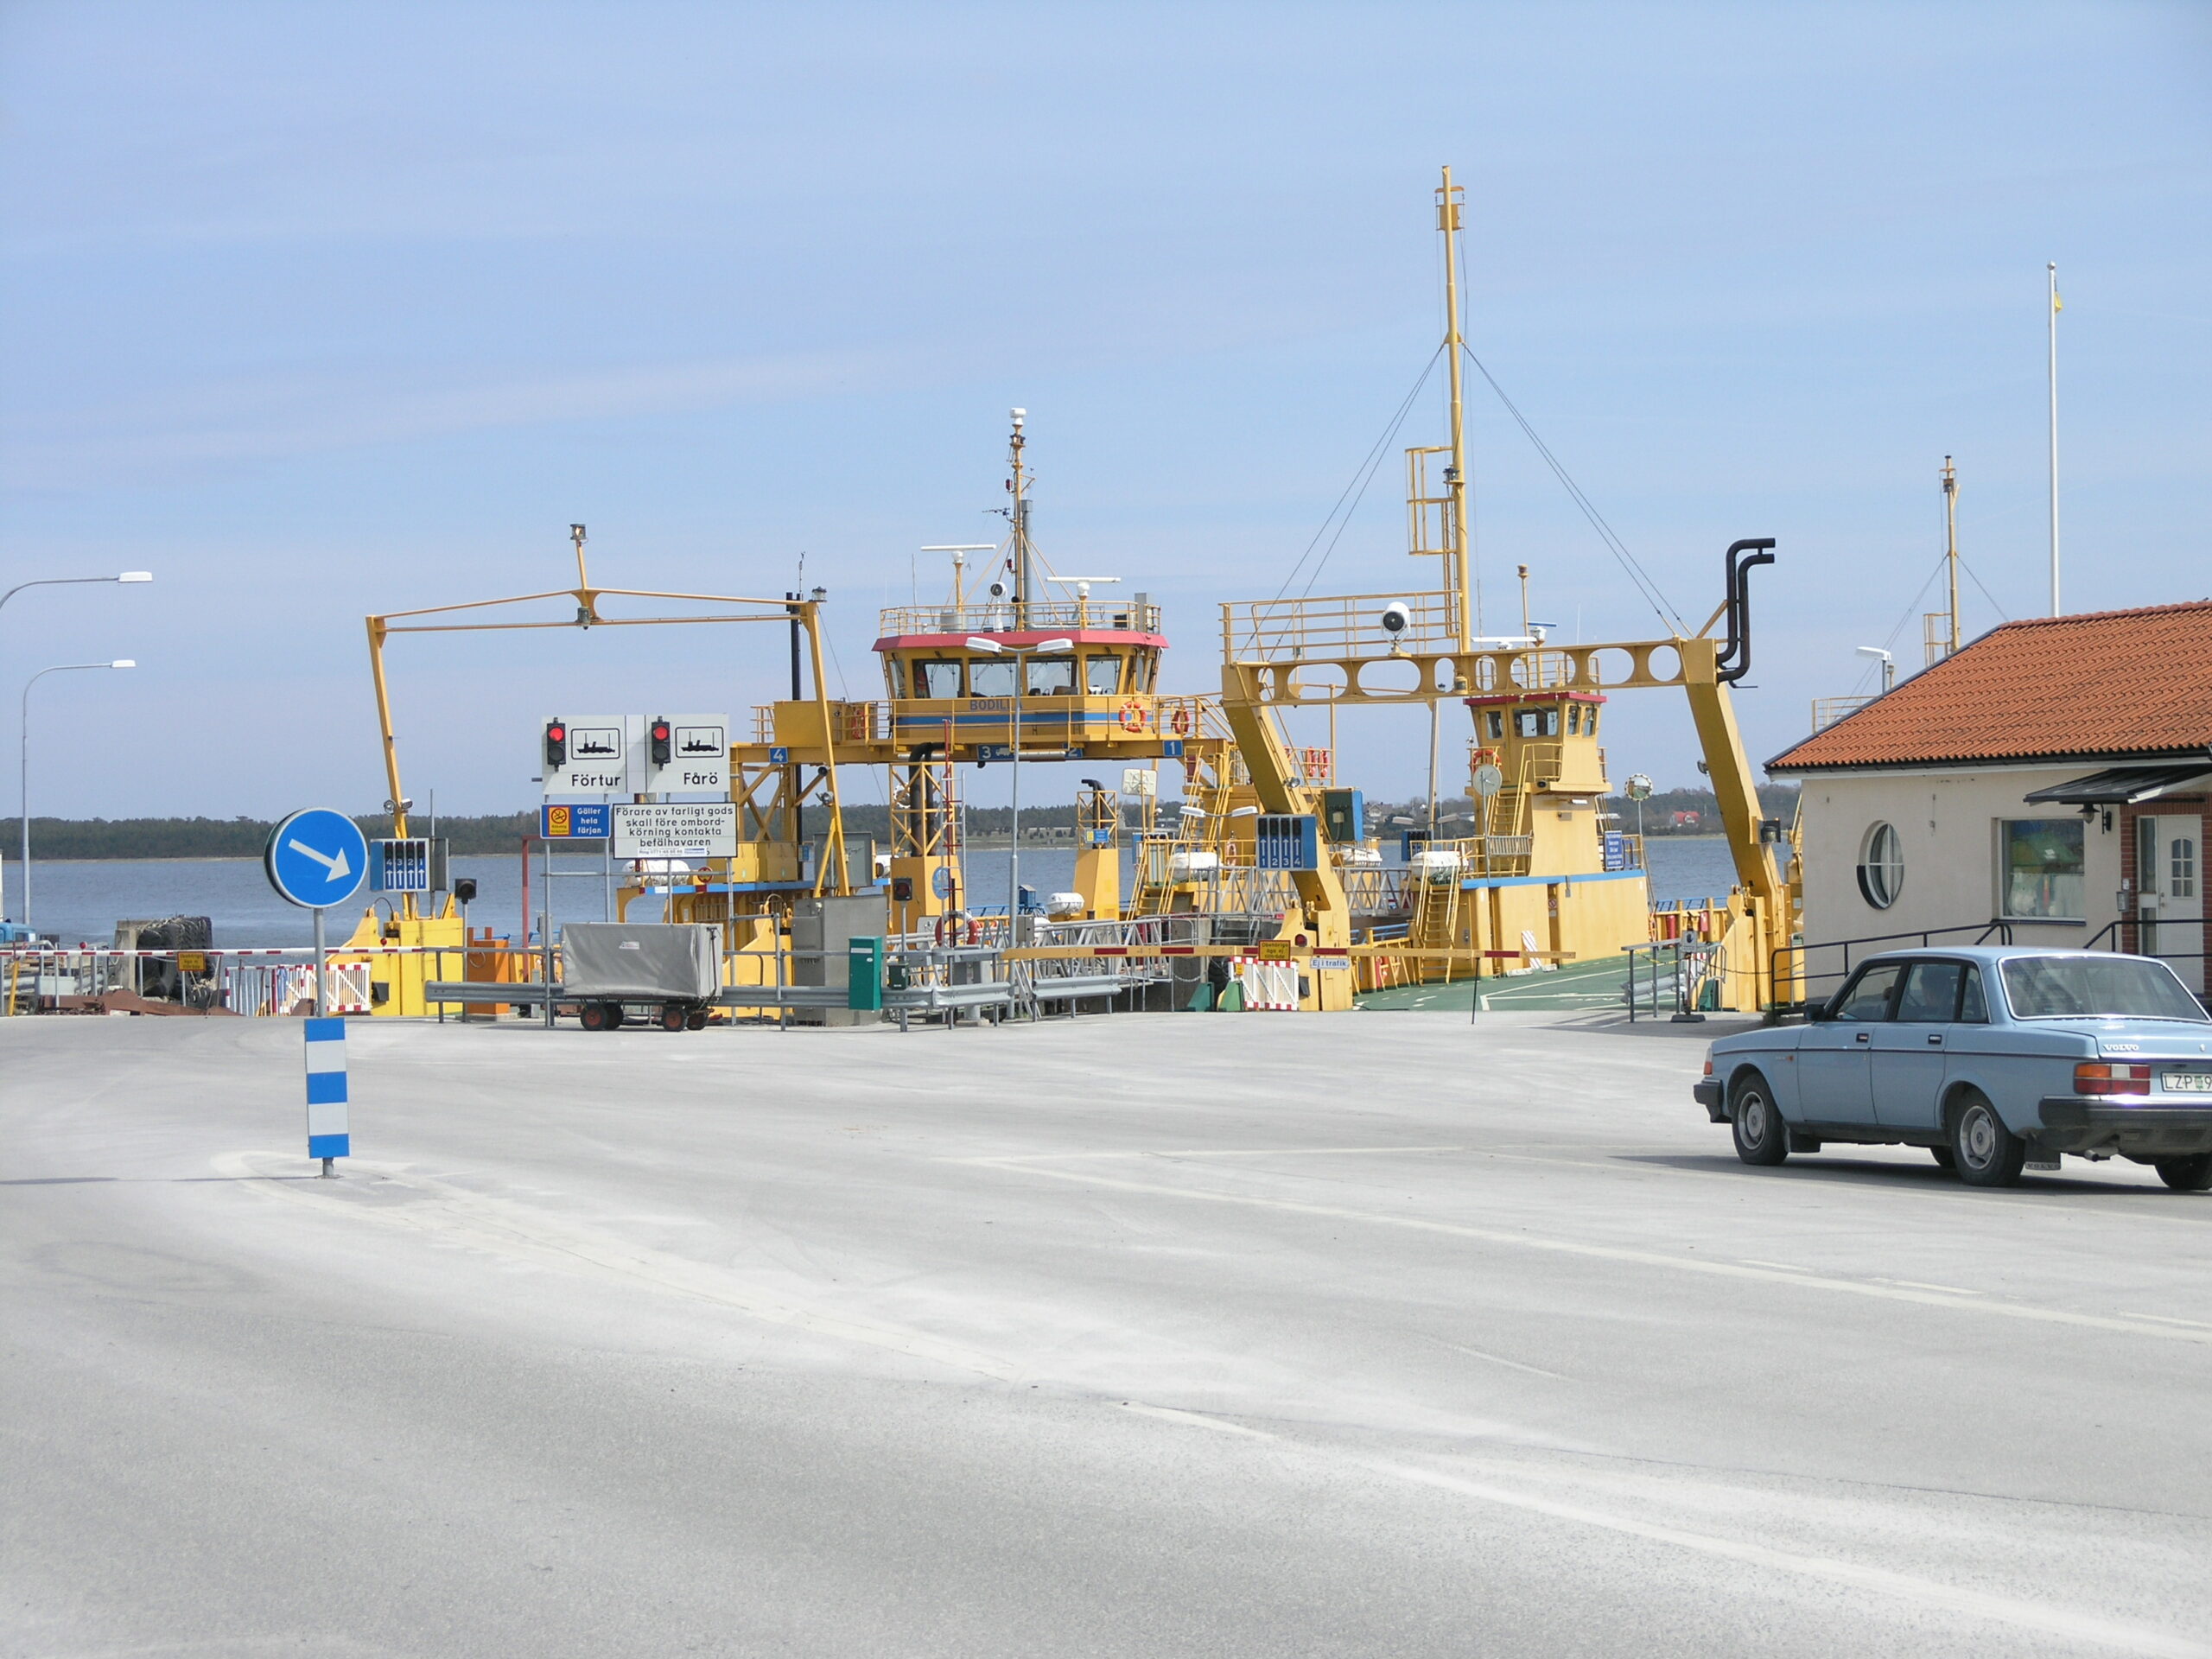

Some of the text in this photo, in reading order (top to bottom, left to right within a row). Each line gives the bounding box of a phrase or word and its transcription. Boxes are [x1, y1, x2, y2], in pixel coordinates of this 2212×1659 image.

[982, 746, 992, 759] 3
[1170, 741, 1175, 755] 1
[773, 748, 784, 761] 4
[571, 774, 621, 787] Förtur
[683, 772, 719, 785] Fårö
[616, 807, 652, 817] Förare
[671, 807, 704, 817] farligt
[707, 806, 734, 817] gods
[626, 817, 725, 827] skall före ombord-
[577, 826, 602, 836] färjan
[629, 827, 721, 838] körning kontakta
[640, 838, 711, 847] befälhavaren
[1272, 857, 1278, 866] 2
[1283, 857, 1289, 866] 3
[1294, 857, 1300, 866] 4
[1313, 959, 1320, 968] Ej
[2102, 1043, 2140, 1052] VOLVO
[2164, 1075, 2193, 1090] LZP
